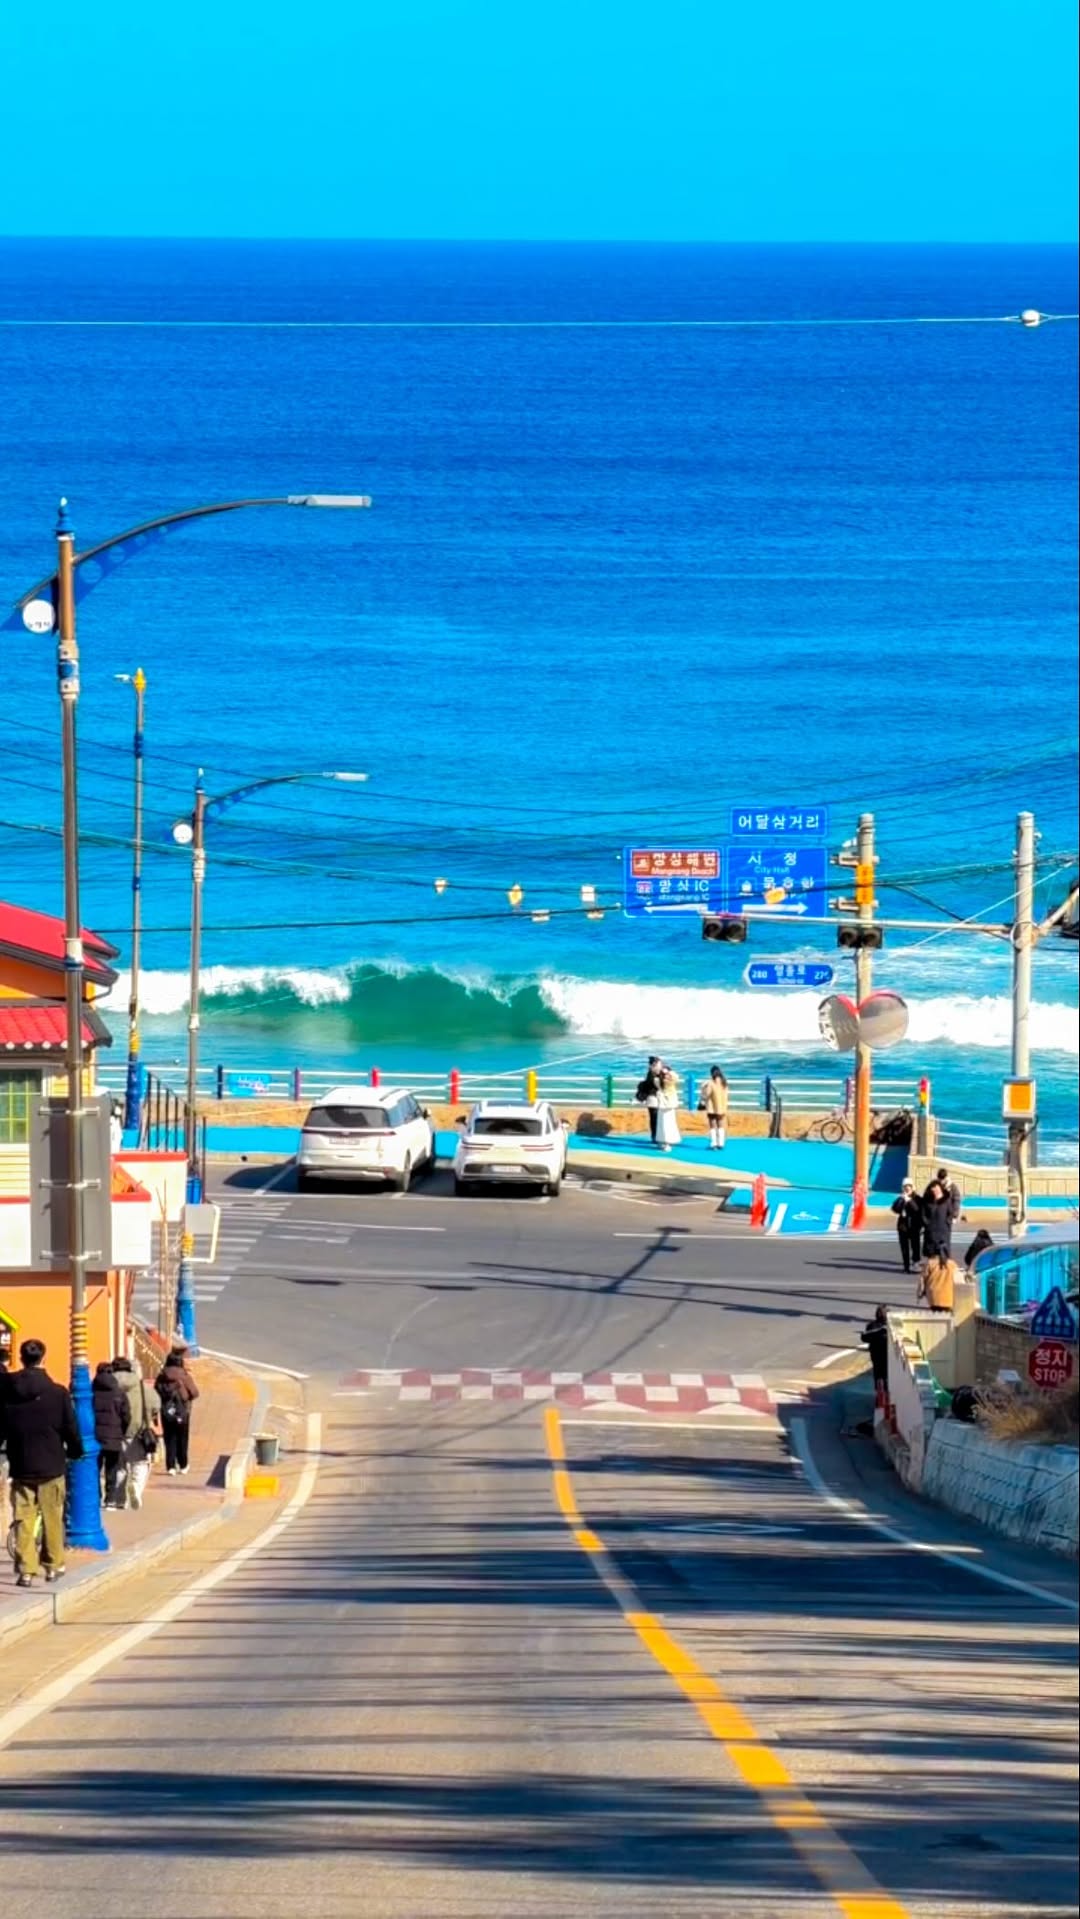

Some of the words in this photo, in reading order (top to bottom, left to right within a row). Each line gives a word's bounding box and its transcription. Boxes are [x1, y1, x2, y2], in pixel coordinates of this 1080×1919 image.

[738, 814, 819, 830] 어달삼거리
[694, 880, 709, 892] IC
[1035, 1349, 1068, 1367] 정지
[1034, 1368, 1067, 1382] STOP
